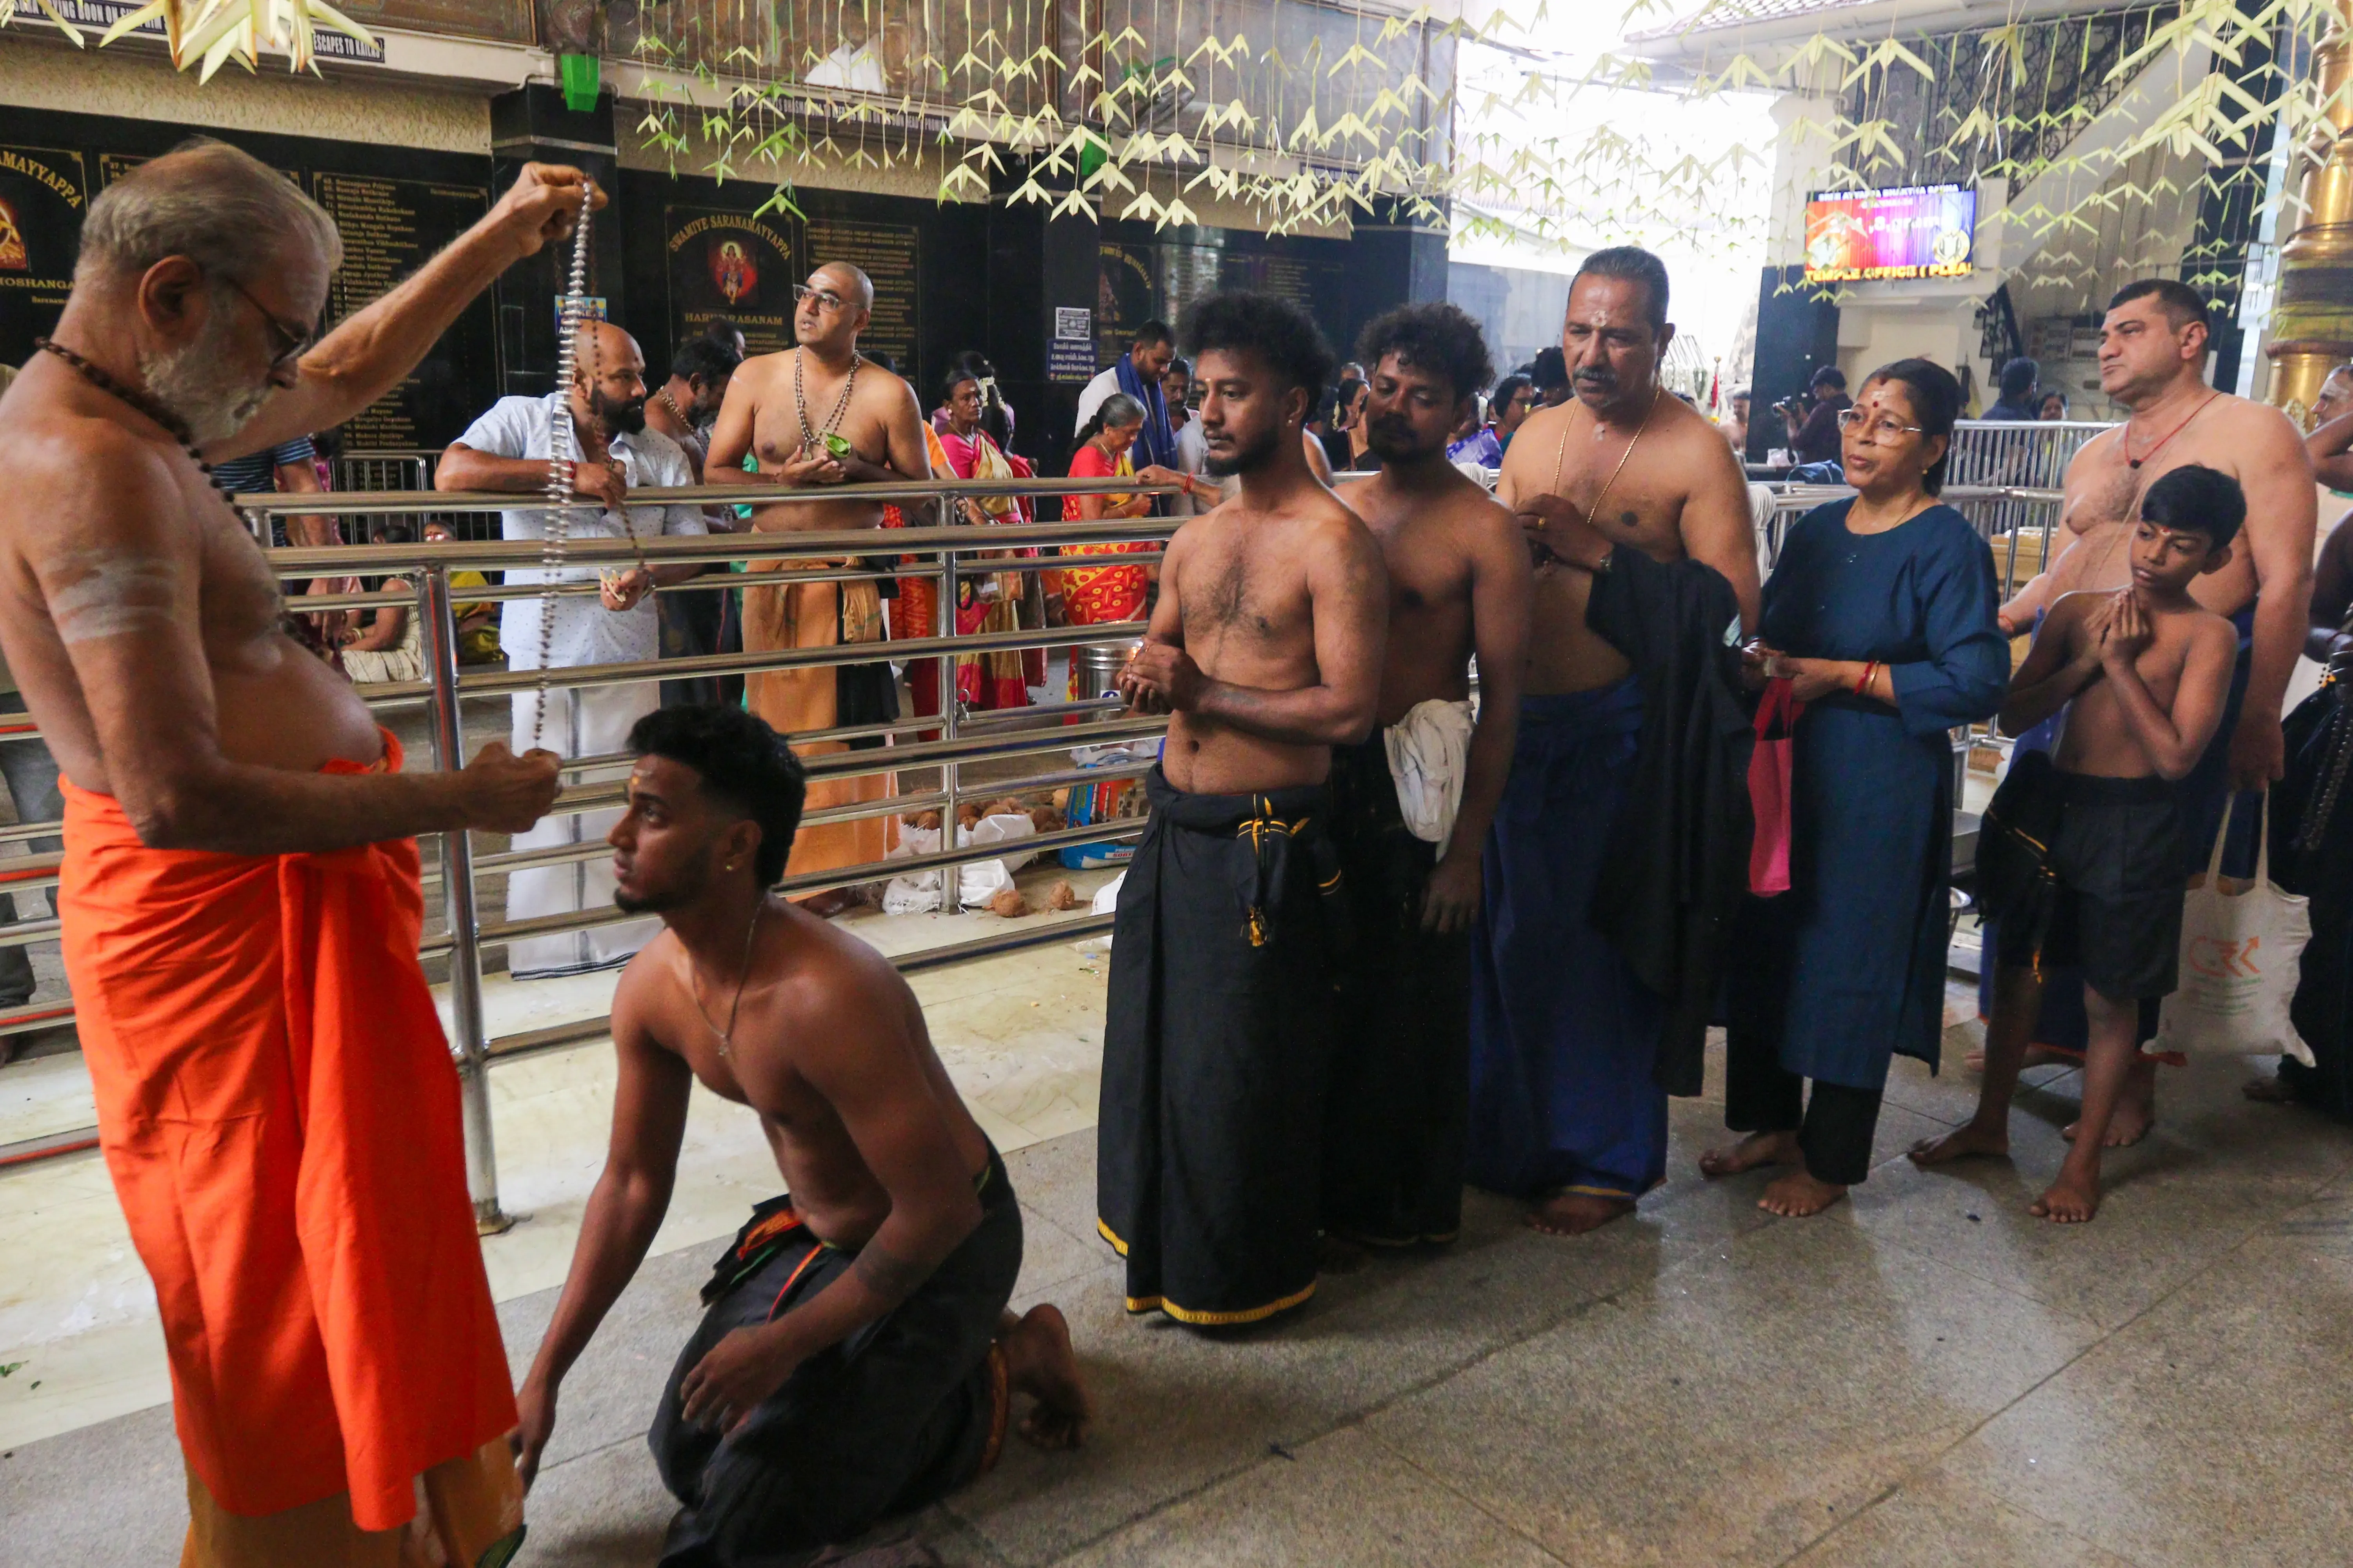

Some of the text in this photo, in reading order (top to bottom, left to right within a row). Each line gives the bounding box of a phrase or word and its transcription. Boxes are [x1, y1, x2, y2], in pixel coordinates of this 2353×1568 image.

[345, 38, 355, 55] TO
[0, 151, 82, 209] MAYYAPPA
[669, 215, 791, 260] SWAMIYE SARANAMAYYAPPA
[1805, 268, 1861, 282] TEMPLE
